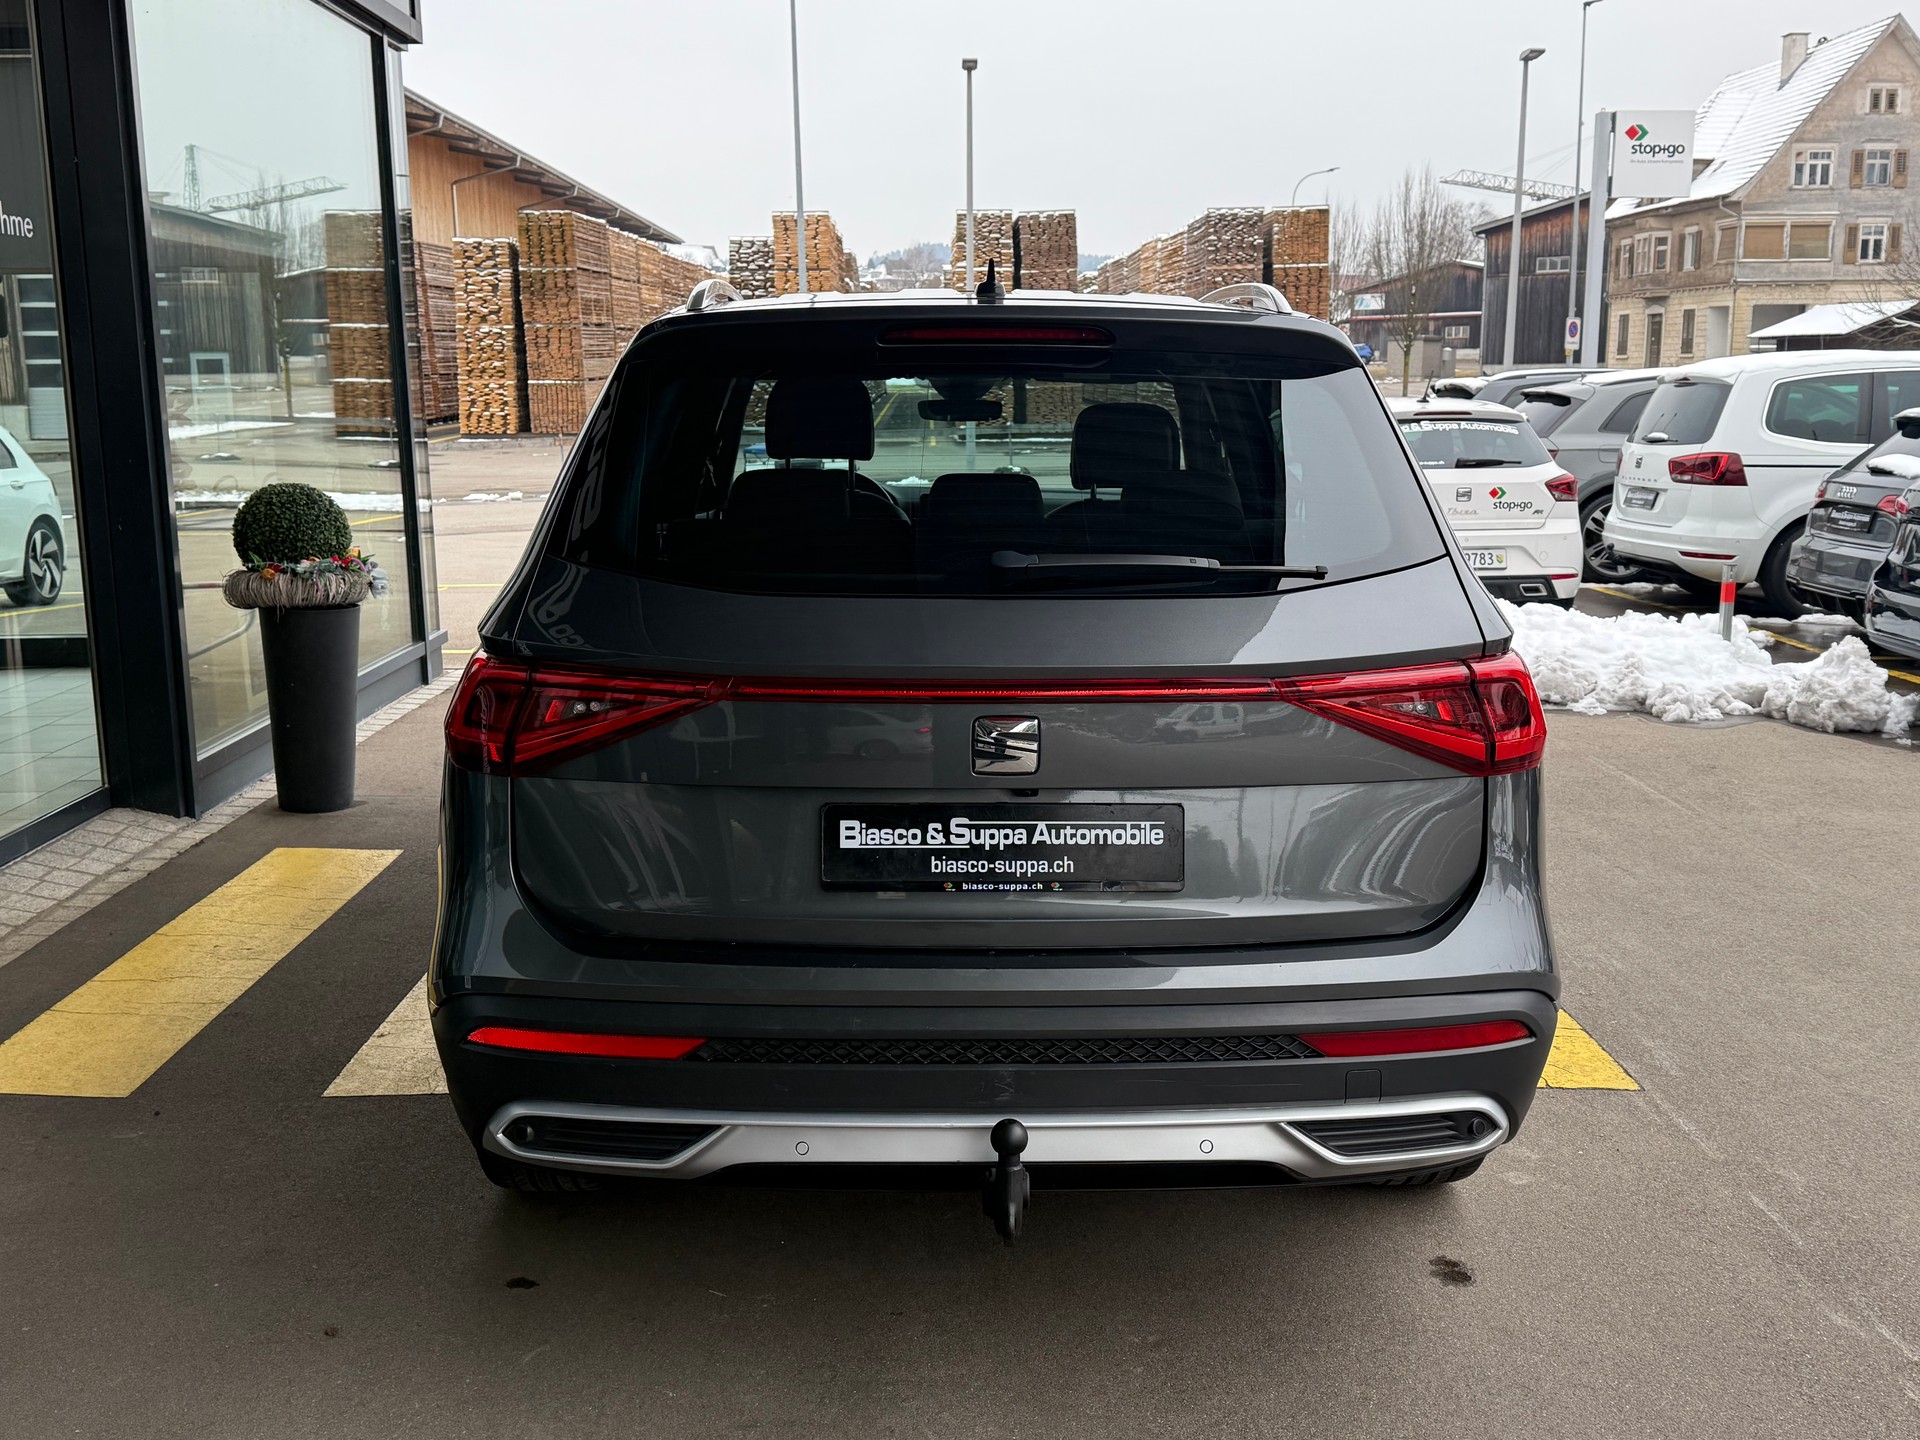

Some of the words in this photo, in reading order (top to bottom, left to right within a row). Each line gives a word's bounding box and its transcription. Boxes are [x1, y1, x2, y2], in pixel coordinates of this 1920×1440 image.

[1631, 142, 1686, 158] stop+go
[1420, 420, 1459, 432] Suppa
[1493, 500, 1533, 512] stop+go
[839, 820, 922, 849] Biasco
[926, 823, 946, 845] &
[950, 817, 1027, 850] Suppa
[1031, 821, 1165, 845] Automobile
[931, 855, 1074, 878] biasco-suppa.ch
[962, 882, 1043, 892] biasco-suppa.ch
